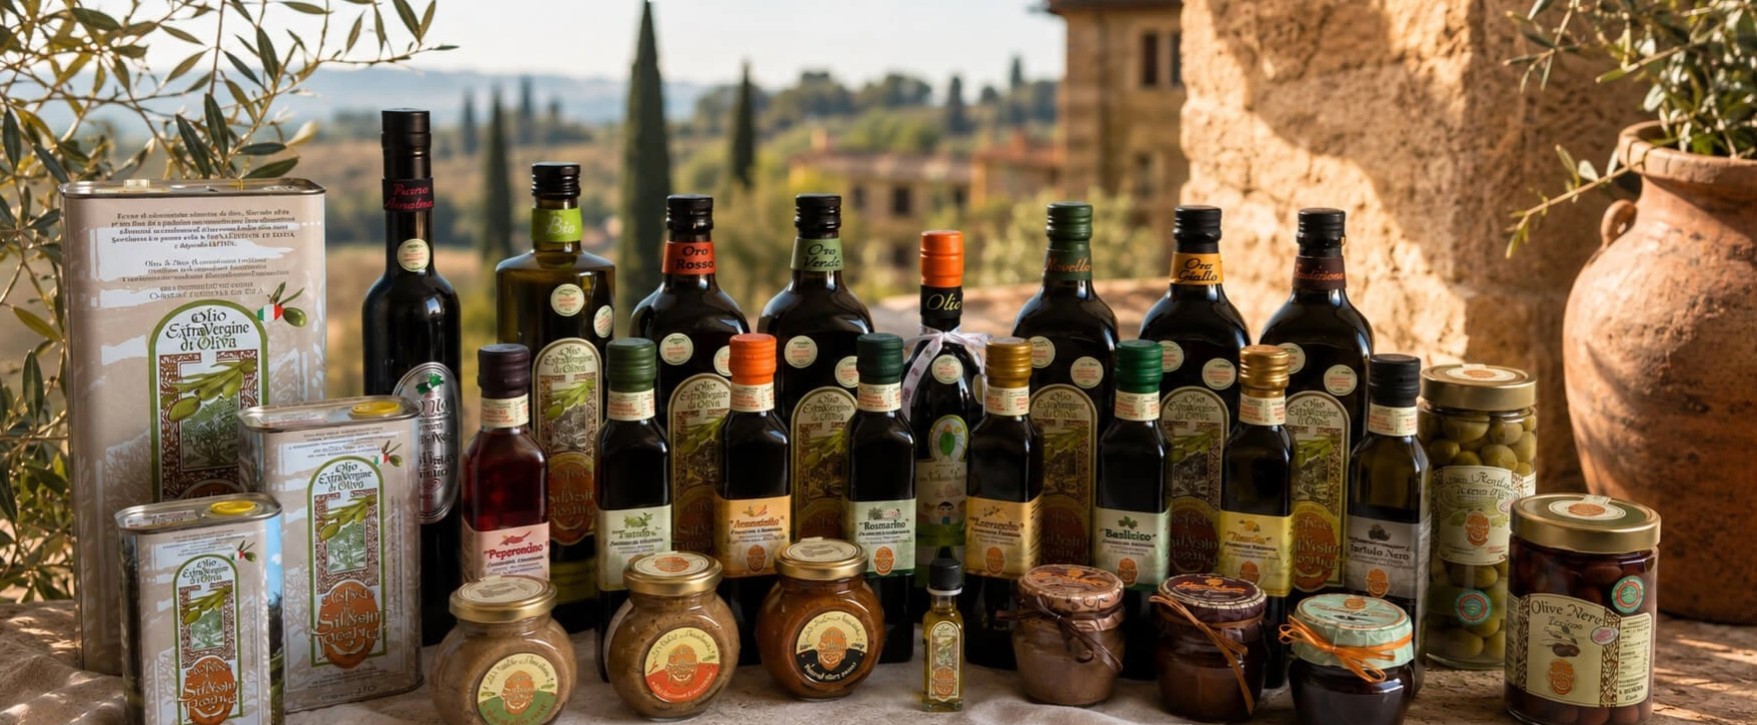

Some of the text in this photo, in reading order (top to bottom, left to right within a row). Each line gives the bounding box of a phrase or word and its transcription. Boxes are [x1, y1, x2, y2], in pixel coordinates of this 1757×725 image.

[547, 216, 576, 234] Bio
[682, 246, 708, 257] Oro
[808, 244, 836, 256] Oro
[676, 258, 714, 270] Rosso
[1178, 270, 1218, 282] Giallo
[927, 293, 961, 310] Olio
[191, 308, 227, 324] Olio
[180, 336, 237, 351] di Oliva
[1530, 601, 1564, 615] Olive
